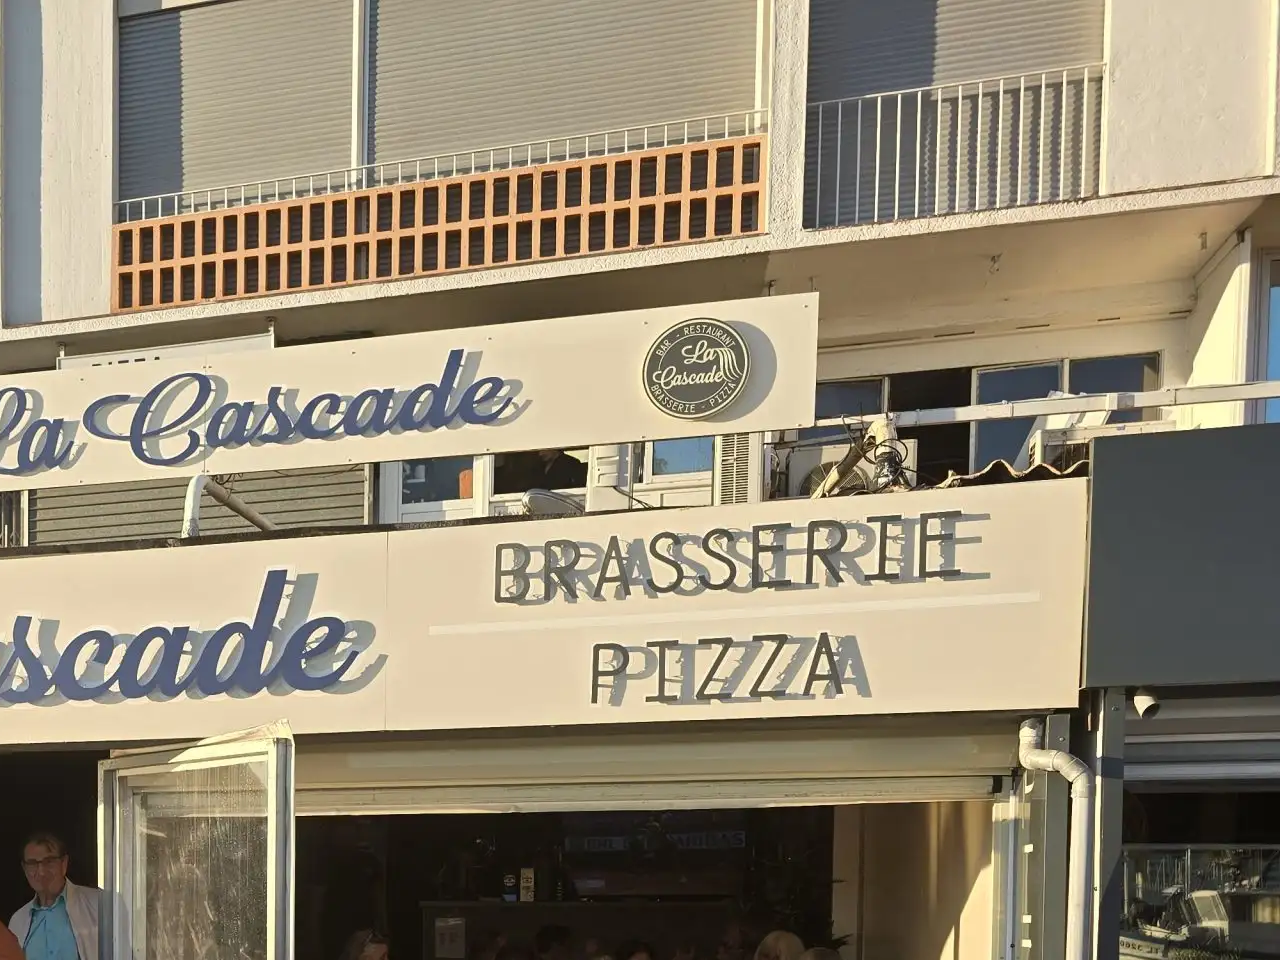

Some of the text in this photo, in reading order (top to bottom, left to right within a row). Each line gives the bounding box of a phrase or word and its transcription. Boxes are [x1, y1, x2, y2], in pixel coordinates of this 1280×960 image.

[656, 324, 736, 356] BAR RESTAURANT
[681, 340, 718, 364] La
[652, 365, 724, 389] Cascade
[83, 349, 515, 465] Cascade
[651, 381, 737, 413] BRASSERIE PIZZA
[494, 510, 962, 604] BRASSERIE
[591, 632, 845, 704] PIZZA
